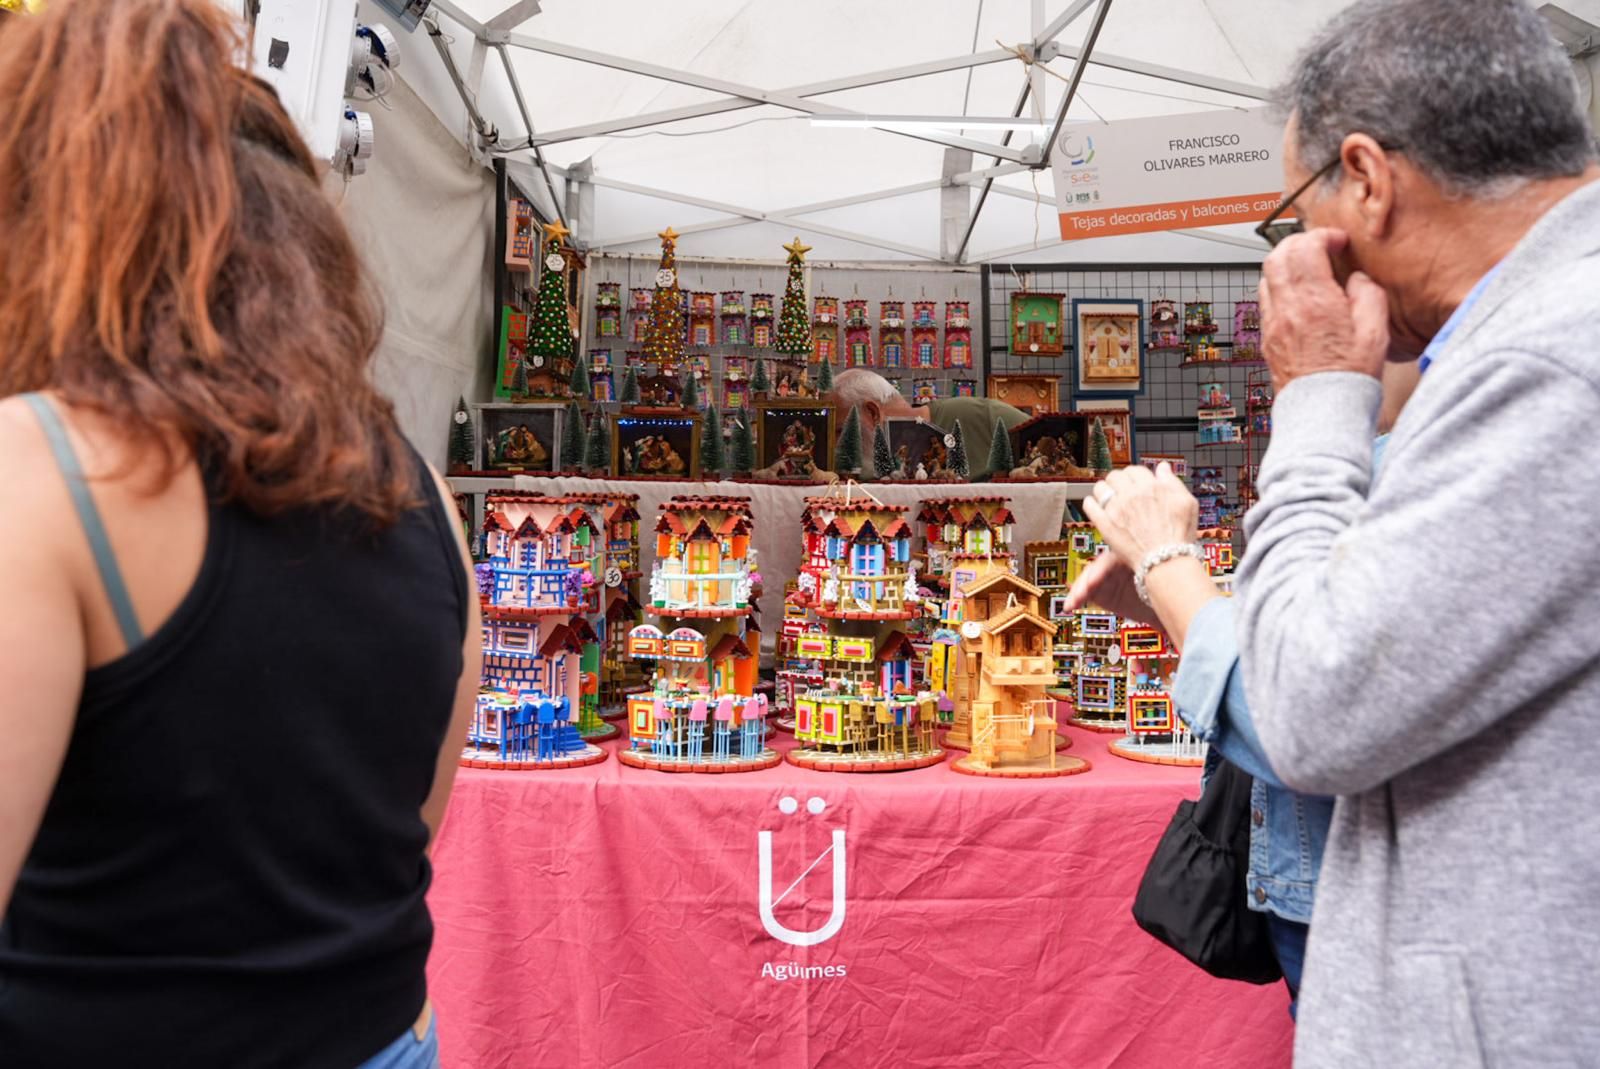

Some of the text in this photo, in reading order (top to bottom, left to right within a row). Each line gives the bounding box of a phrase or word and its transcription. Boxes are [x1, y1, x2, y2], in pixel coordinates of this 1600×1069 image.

[1169, 134, 1240, 151] FRANCISCO
[1144, 149, 1270, 172] OLIVARES MARRERO
[1071, 215, 1105, 231] Tejas
[1109, 206, 1177, 226] decoradas
[1180, 207, 1188, 222] y
[1192, 198, 1249, 216] balcones
[659, 271, 672, 283] 35
